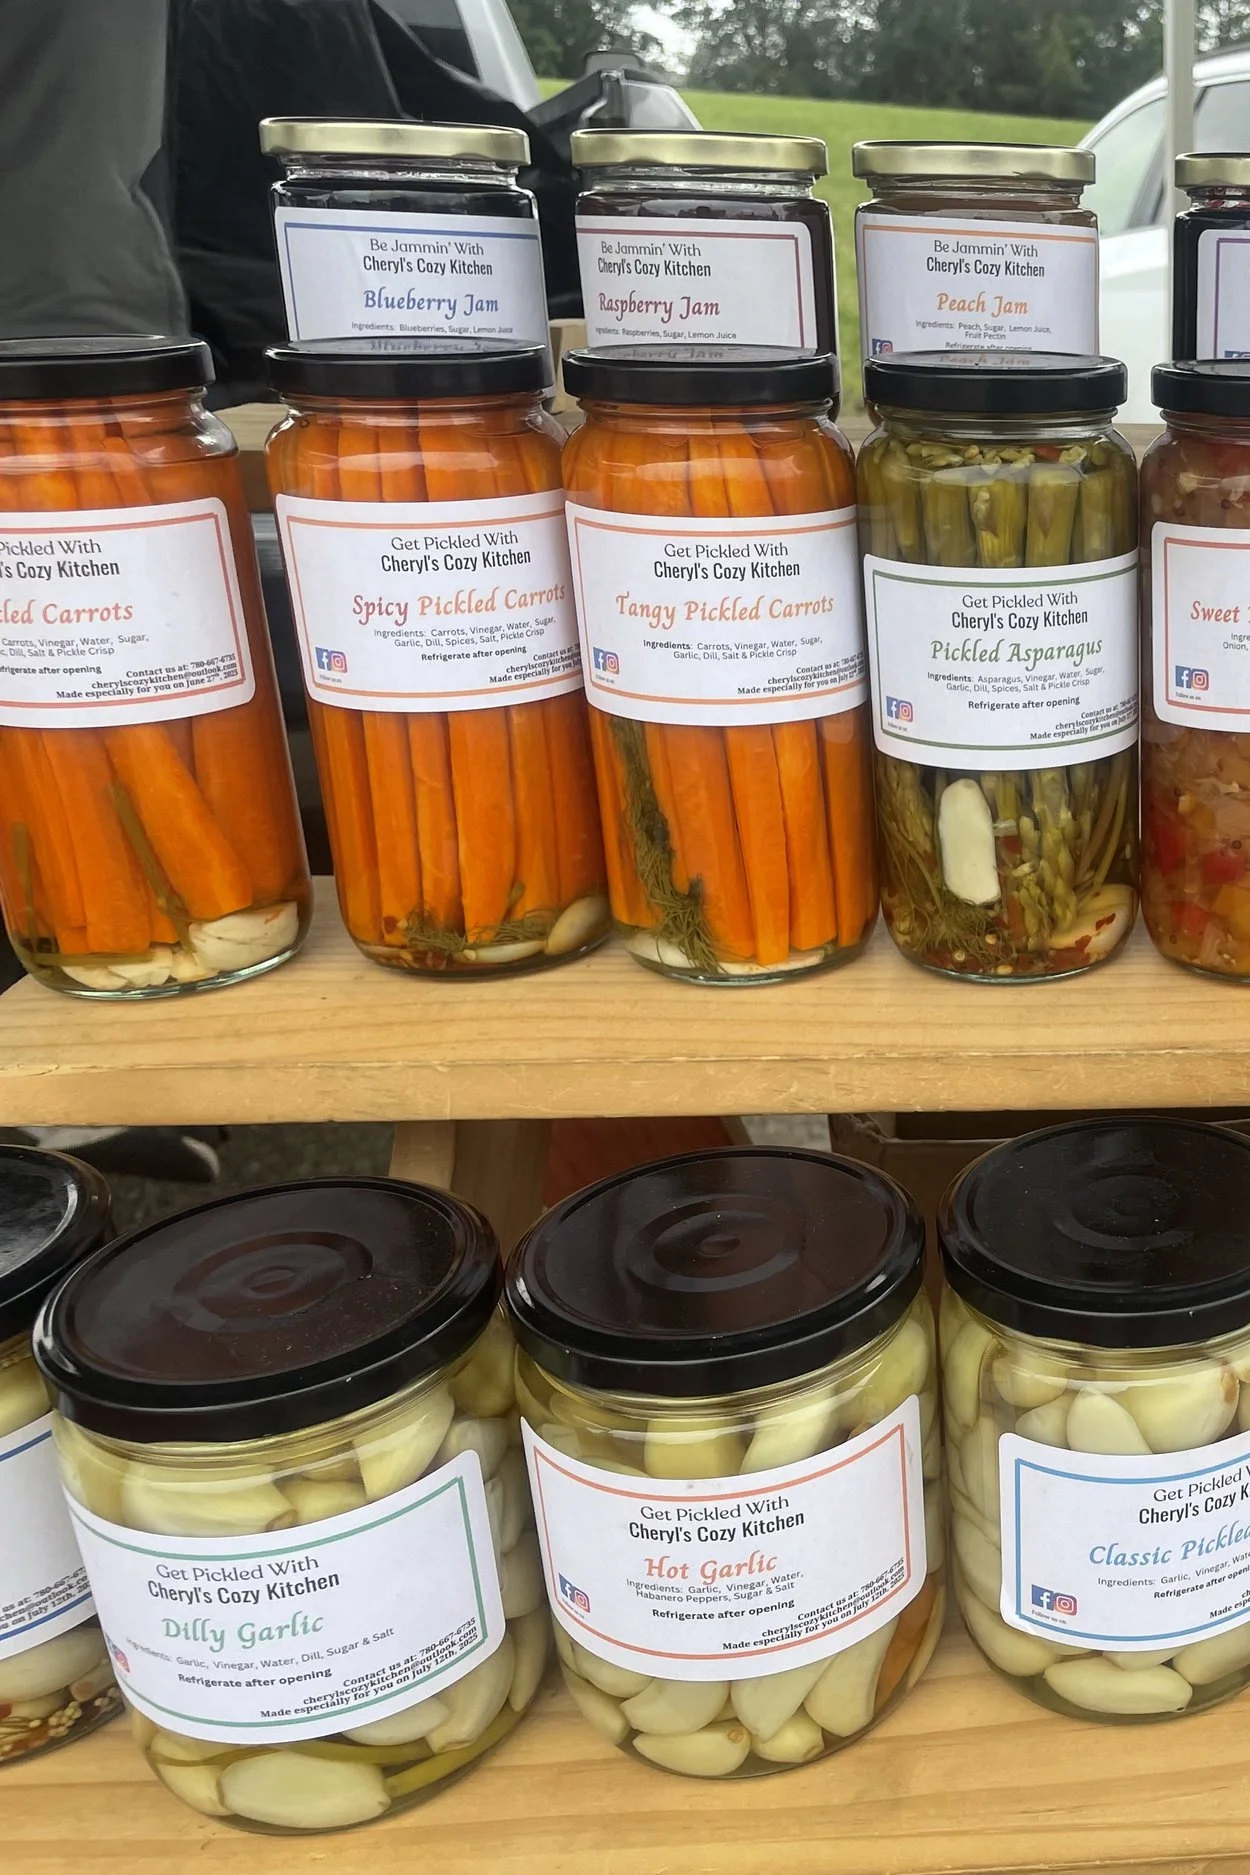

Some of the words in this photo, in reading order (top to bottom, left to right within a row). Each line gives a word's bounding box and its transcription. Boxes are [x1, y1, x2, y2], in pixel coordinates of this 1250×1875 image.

[370, 238, 387, 251] Be
[391, 239, 451, 254] Jammin'
[454, 242, 484, 255] With
[363, 256, 413, 273] Cheryl's
[417, 258, 445, 276] Cozy
[450, 259, 492, 275] Kitchen
[598, 258, 632, 275] Cheryl's
[635, 259, 660, 277] Cozy
[664, 260, 711, 277] Kitchen
[927, 257, 970, 275] Cheryl's
[974, 260, 1000, 276] Cozy
[1005, 262, 1045, 277] Kitchen
[364, 287, 457, 320] Blueberry
[464, 294, 499, 316] Jam
[599, 290, 673, 323] Raspberry
[679, 297, 720, 319] Jam
[937, 291, 985, 313] Peach
[991, 296, 1028, 318] Jam
[965, 331, 982, 339] Fruit
[984, 332, 1006, 340] Pectin
[664, 544, 691, 558] Get
[696, 544, 750, 558] Pickled
[754, 542, 788, 556] With
[17, 561, 52, 580] Cozy
[58, 561, 120, 578] Kitchen
[654, 562, 709, 580] Cheryl's
[714, 562, 746, 581] Cozy
[751, 561, 800, 578] Kitchen
[43, 603, 134, 624] Carrots
[352, 595, 409, 627] Spicy
[417, 587, 500, 616] Pickled
[505, 584, 565, 610] Carrots
[616, 592, 676, 630] Tangy
[684, 596, 762, 622] Pickled
[769, 596, 834, 619] Carrots
[1191, 601, 1240, 623] Sweet
[952, 612, 1004, 631] Cheryl's
[1009, 613, 1039, 631] Cozy
[1043, 609, 1088, 627] Kitchen
[421, 652, 470, 662] Refrigerate
[472, 651, 493, 660] after
[495, 645, 527, 658] opening
[931, 638, 1005, 662] Pickled
[1007, 639, 1102, 672] Asparagus
[1023, 683, 1039, 691] Salt
[1048, 681, 1070, 690] Pickle
[1072, 678, 1090, 689] Crisp
[1139, 1502, 1199, 1524] Cheryl's
[1204, 1492, 1236, 1513] Cozy
[1089, 1543, 1172, 1566] Classic
[645, 1556, 689, 1580] Hot
[700, 1550, 777, 1585] Garlic
[147, 1580, 213, 1605] Cheryl's
[218, 1586, 260, 1605] Cozy
[266, 1571, 340, 1599] Kitchen
[626, 1578, 683, 1594] Ingredients:
[688, 1584, 721, 1595] Garlic,
[725, 1578, 767, 1593] Vinegar,
[771, 1571, 803, 1584] Water,
[635, 1589, 683, 1603] Habanero
[685, 1593, 731, 1605] Peppers,
[733, 1588, 763, 1602] Sugar
[766, 1586, 773, 1596] &
[775, 1582, 794, 1594] Salt
[161, 1617, 226, 1653] Dilly
[237, 1610, 324, 1650] Garlic
[343, 1668, 386, 1687] Contact
[389, 1663, 401, 1672] us
[419, 1617, 476, 1658] 780-667-6735
[178, 1673, 242, 1689] Refrigerate
[245, 1676, 276, 1687] after
[279, 1667, 332, 1686] opening
[260, 1709, 291, 1718] Made
[294, 1696, 350, 1715] especially
[354, 1690, 370, 1701] for
[373, 1682, 394, 1696] you
[396, 1676, 410, 1685] on
[410, 1664, 432, 1680] July
[459, 1633, 478, 1651] 2025
